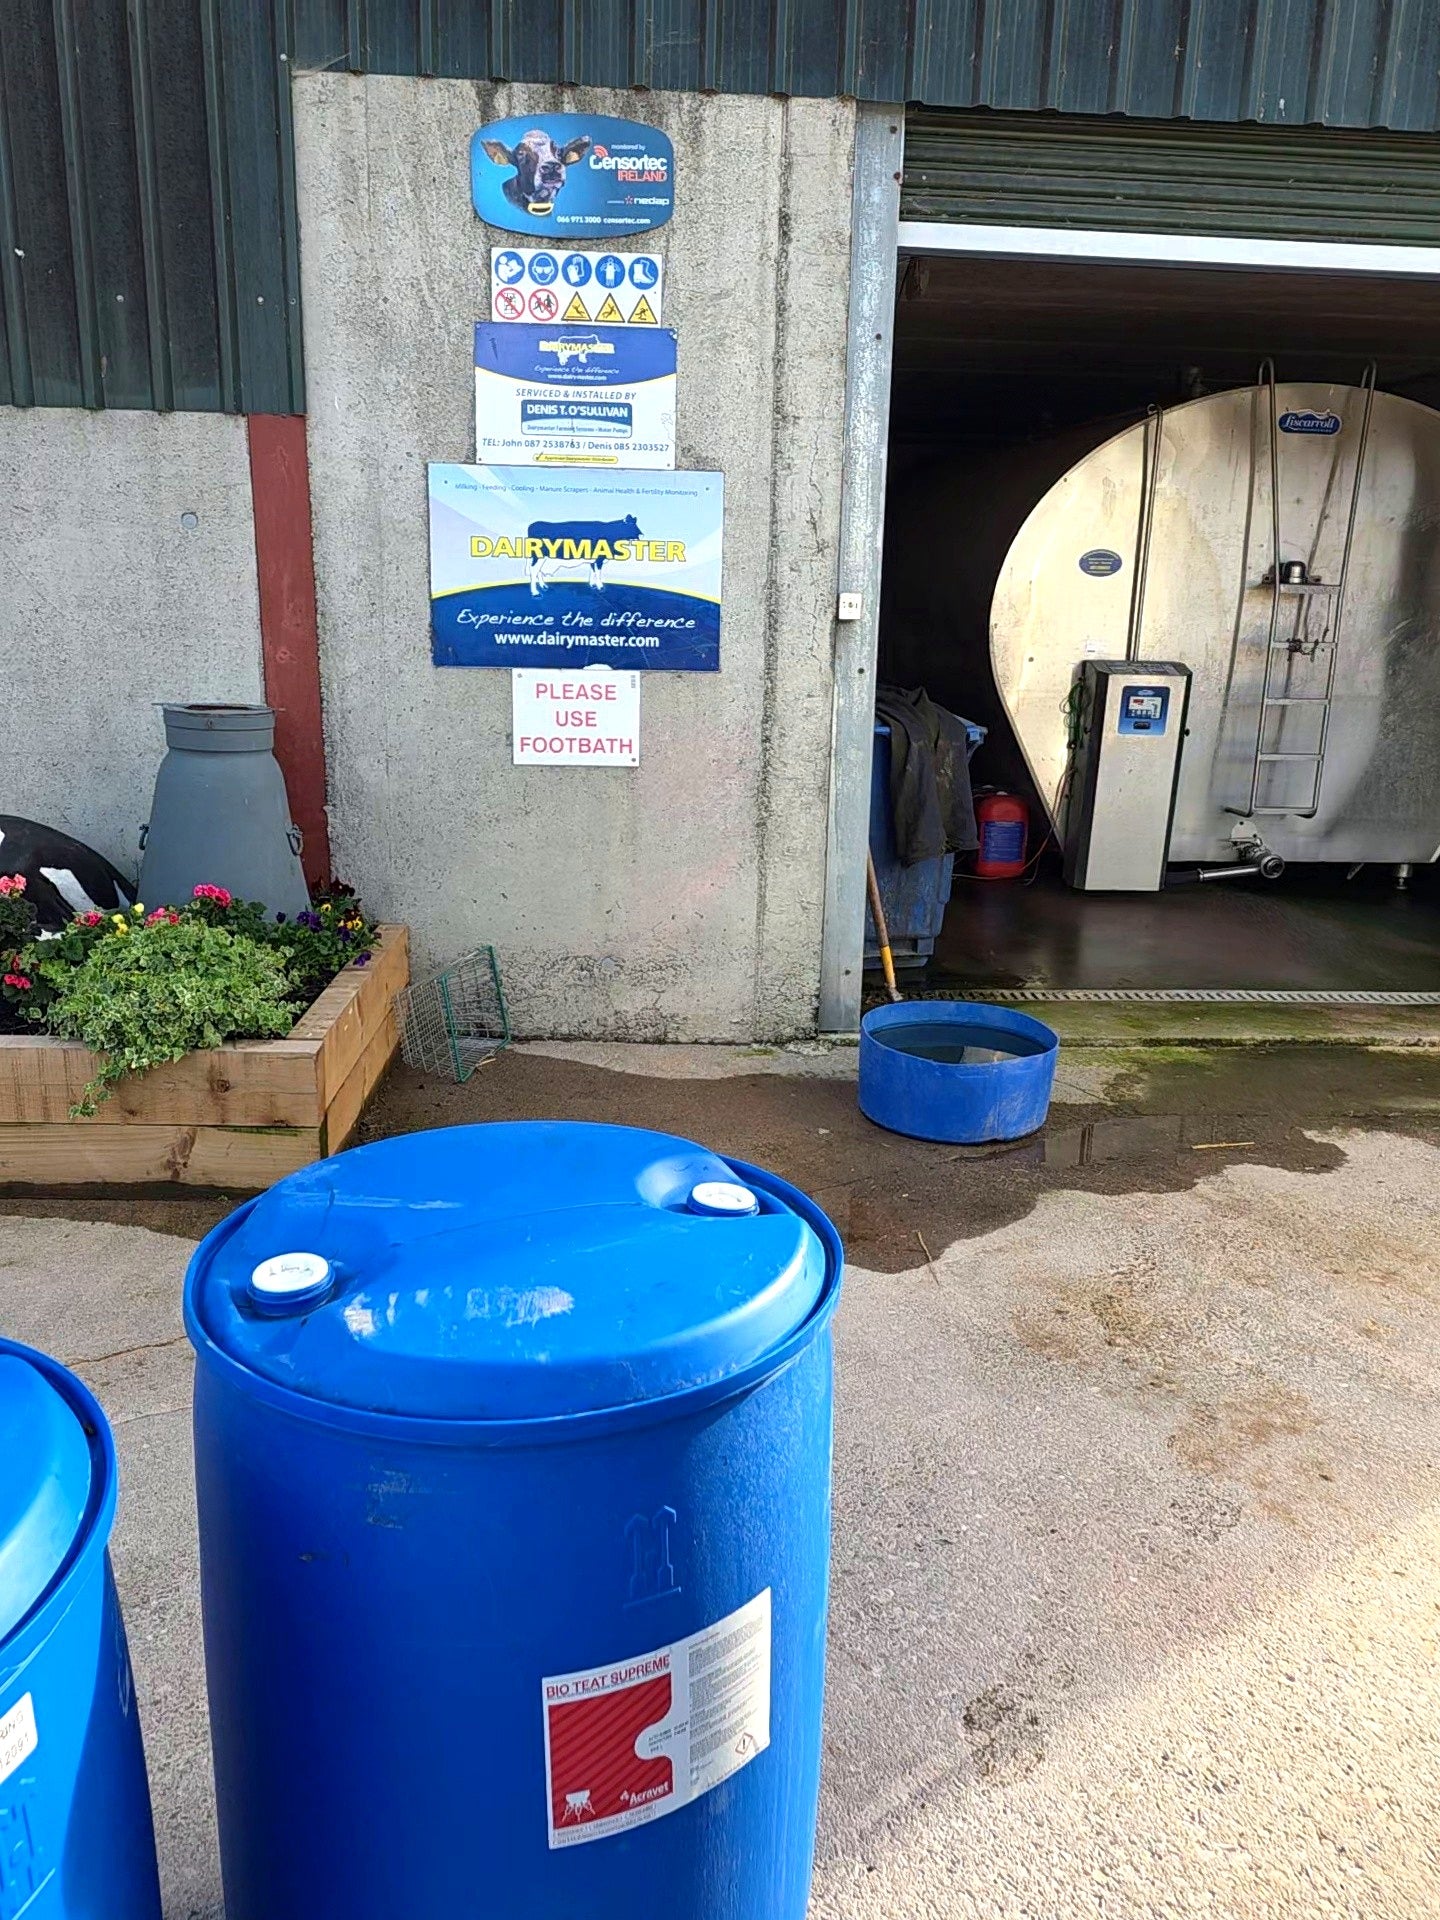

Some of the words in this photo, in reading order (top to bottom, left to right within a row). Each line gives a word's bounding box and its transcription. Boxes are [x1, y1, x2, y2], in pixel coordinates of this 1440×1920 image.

[589, 154, 668, 170] Censortec
[618, 170, 667, 182] IRELAND
[634, 197, 670, 206] nedap
[516, 388, 561, 398] SERVICED
[563, 390, 570, 398] &
[572, 390, 622, 400] INSTALLED
[624, 392, 637, 400] BY
[527, 404, 558, 415] DENIS
[559, 405, 568, 415] T.
[568, 405, 628, 418] O'SULLIVAN
[482, 438, 500, 447] TEL:
[501, 439, 523, 447] John
[524, 440, 541, 448] 087
[588, 441, 612, 450] Denis
[614, 442, 630, 450] 085
[632, 443, 669, 452] 2303527
[511, 485, 534, 493] Cooling
[563, 486, 589, 494] Scrapers
[641, 488, 664, 496] Fertility
[470, 535, 686, 562] DAIRYMASTER
[457, 608, 555, 630] Experience
[562, 611, 593, 627] the
[601, 611, 696, 629] difference
[494, 631, 660, 649] www.dairymaster.com
[536, 683, 617, 701] PLEASE
[555, 710, 597, 727] USE
[520, 737, 633, 754] FOOTBATH
[546, 1684, 570, 1700] BIO
[572, 1675, 608, 1694] TEAT
[610, 1653, 670, 1686] SUPREME
[630, 1781, 669, 1807] Acravet
